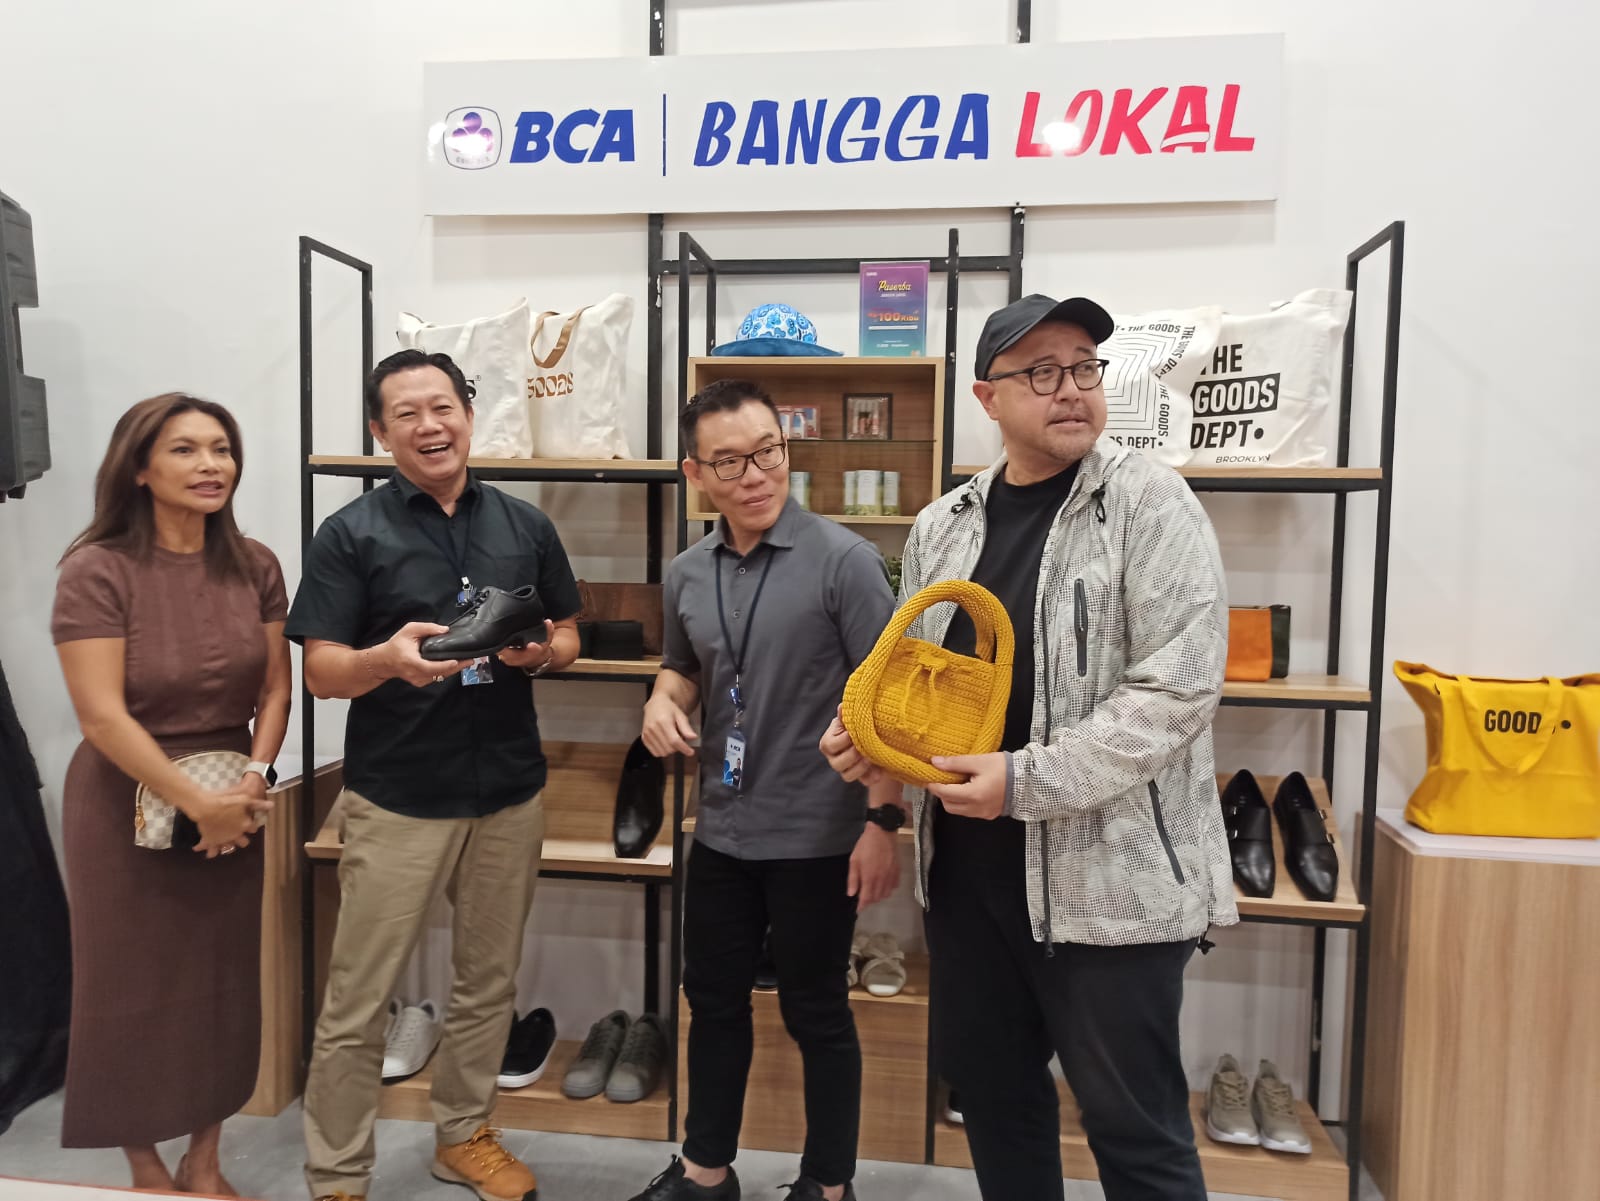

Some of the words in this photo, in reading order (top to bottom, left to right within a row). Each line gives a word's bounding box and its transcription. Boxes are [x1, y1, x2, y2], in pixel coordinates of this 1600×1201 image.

[509, 108, 635, 164] BCA
[693, 93, 989, 168] BANGGA
[1014, 84, 1256, 158] LOKAL
[1148, 323, 1181, 334] GOODS
[1194, 377, 1276, 415] GOODS
[1158, 403, 1170, 437] GOODS
